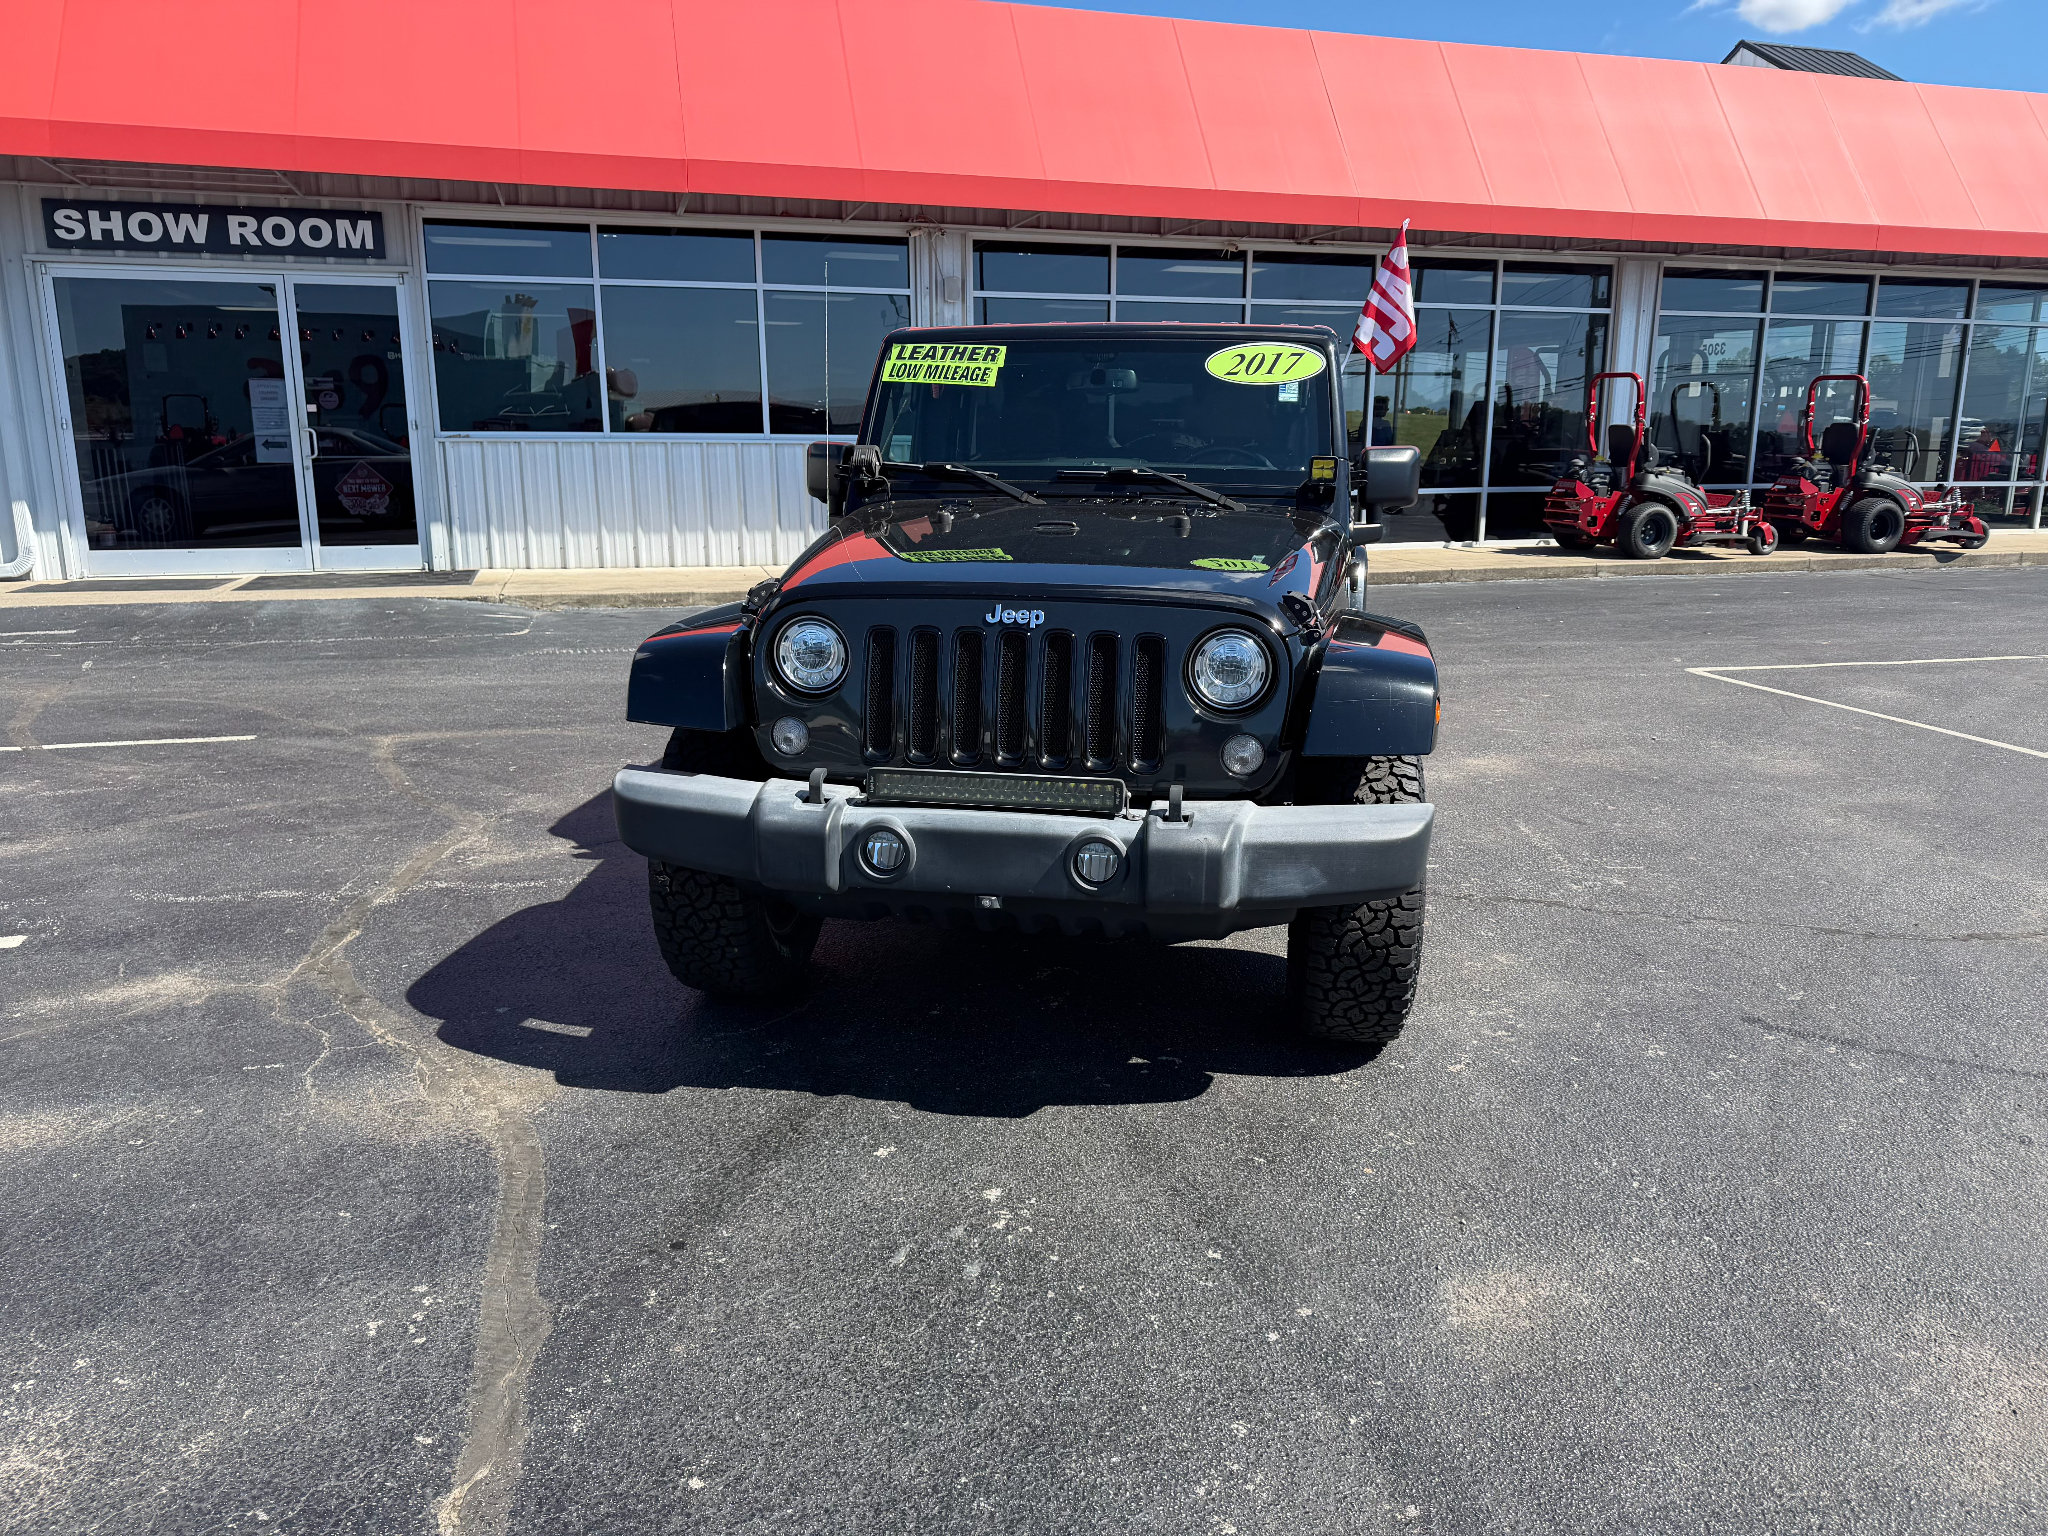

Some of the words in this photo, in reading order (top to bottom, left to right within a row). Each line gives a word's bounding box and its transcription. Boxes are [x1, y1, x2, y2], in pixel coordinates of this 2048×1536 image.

[53, 208, 209, 244] SHOW
[227, 214, 375, 250] ROOM
[895, 345, 1002, 364] LEATHER
[1224, 352, 1306, 376] 2017
[888, 363, 923, 379] LOW
[923, 364, 993, 383] MILEAGE
[985, 604, 1045, 628] Jeep
